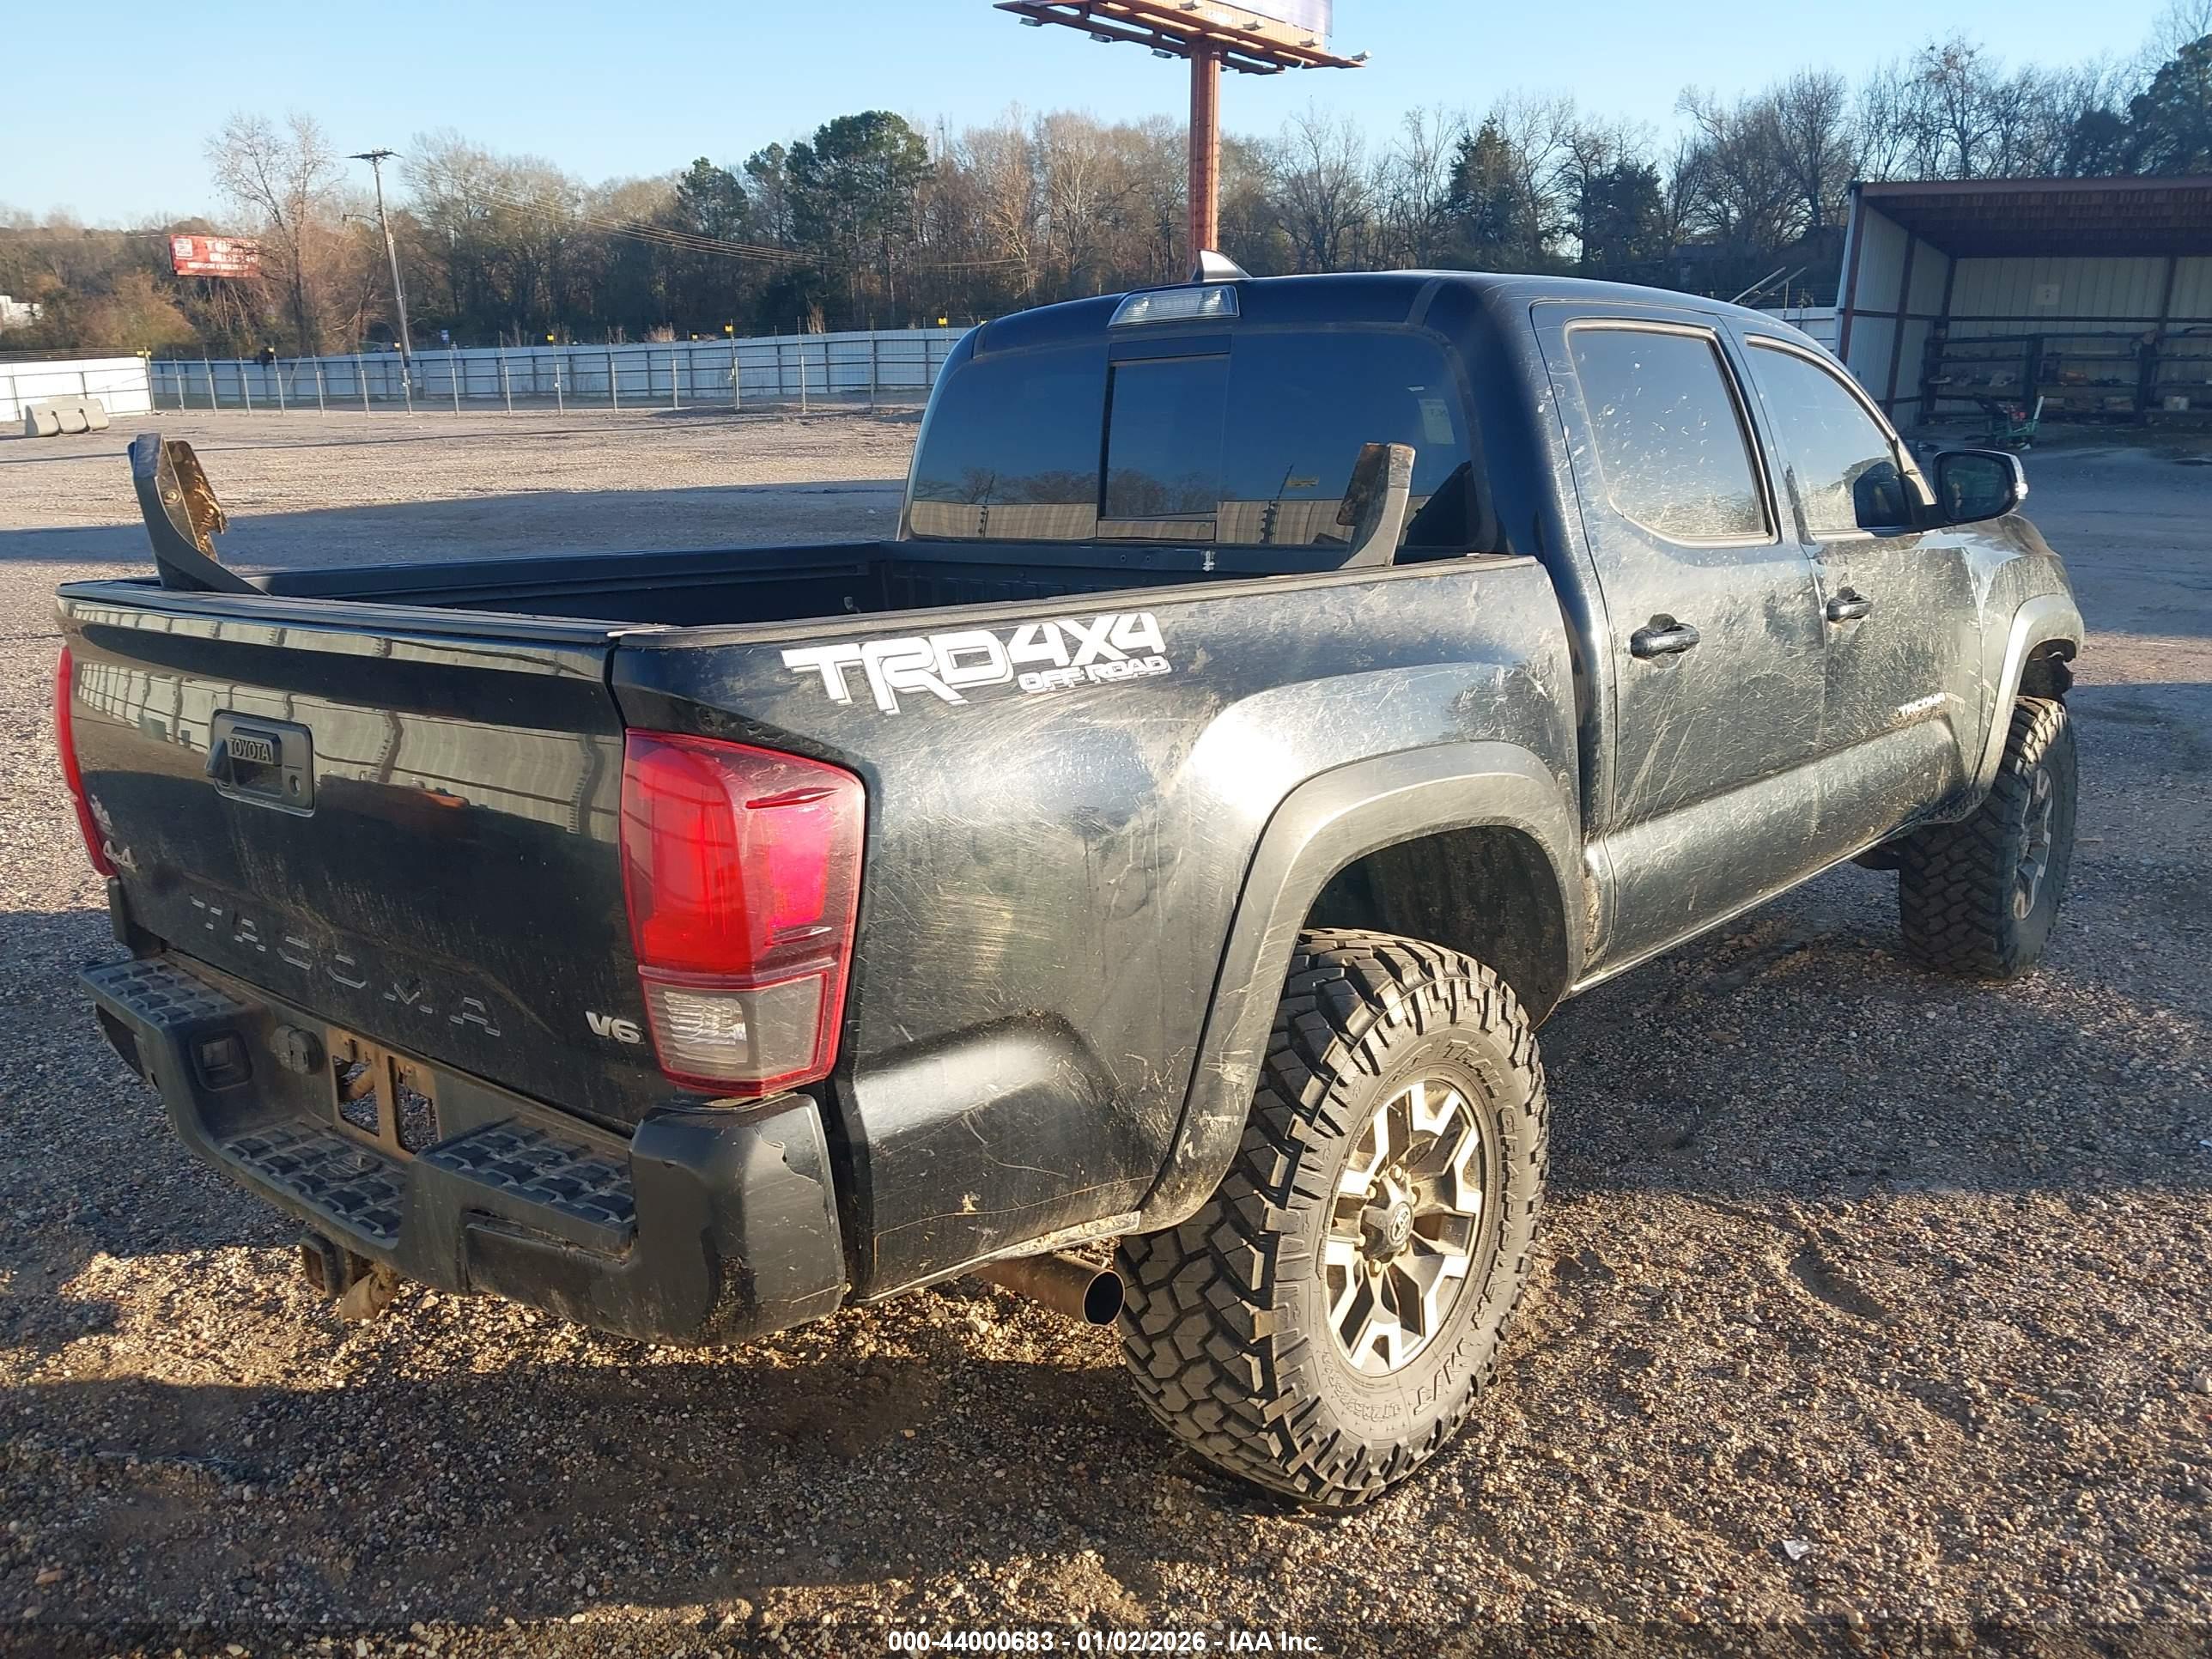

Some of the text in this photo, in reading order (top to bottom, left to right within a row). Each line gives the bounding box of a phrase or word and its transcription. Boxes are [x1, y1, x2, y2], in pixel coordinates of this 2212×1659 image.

[781, 627, 1013, 715] TRD
[1018, 655, 1173, 694] OFF ROAD
[228, 737, 273, 763] TOYOTA
[585, 1010, 641, 1044] V6
